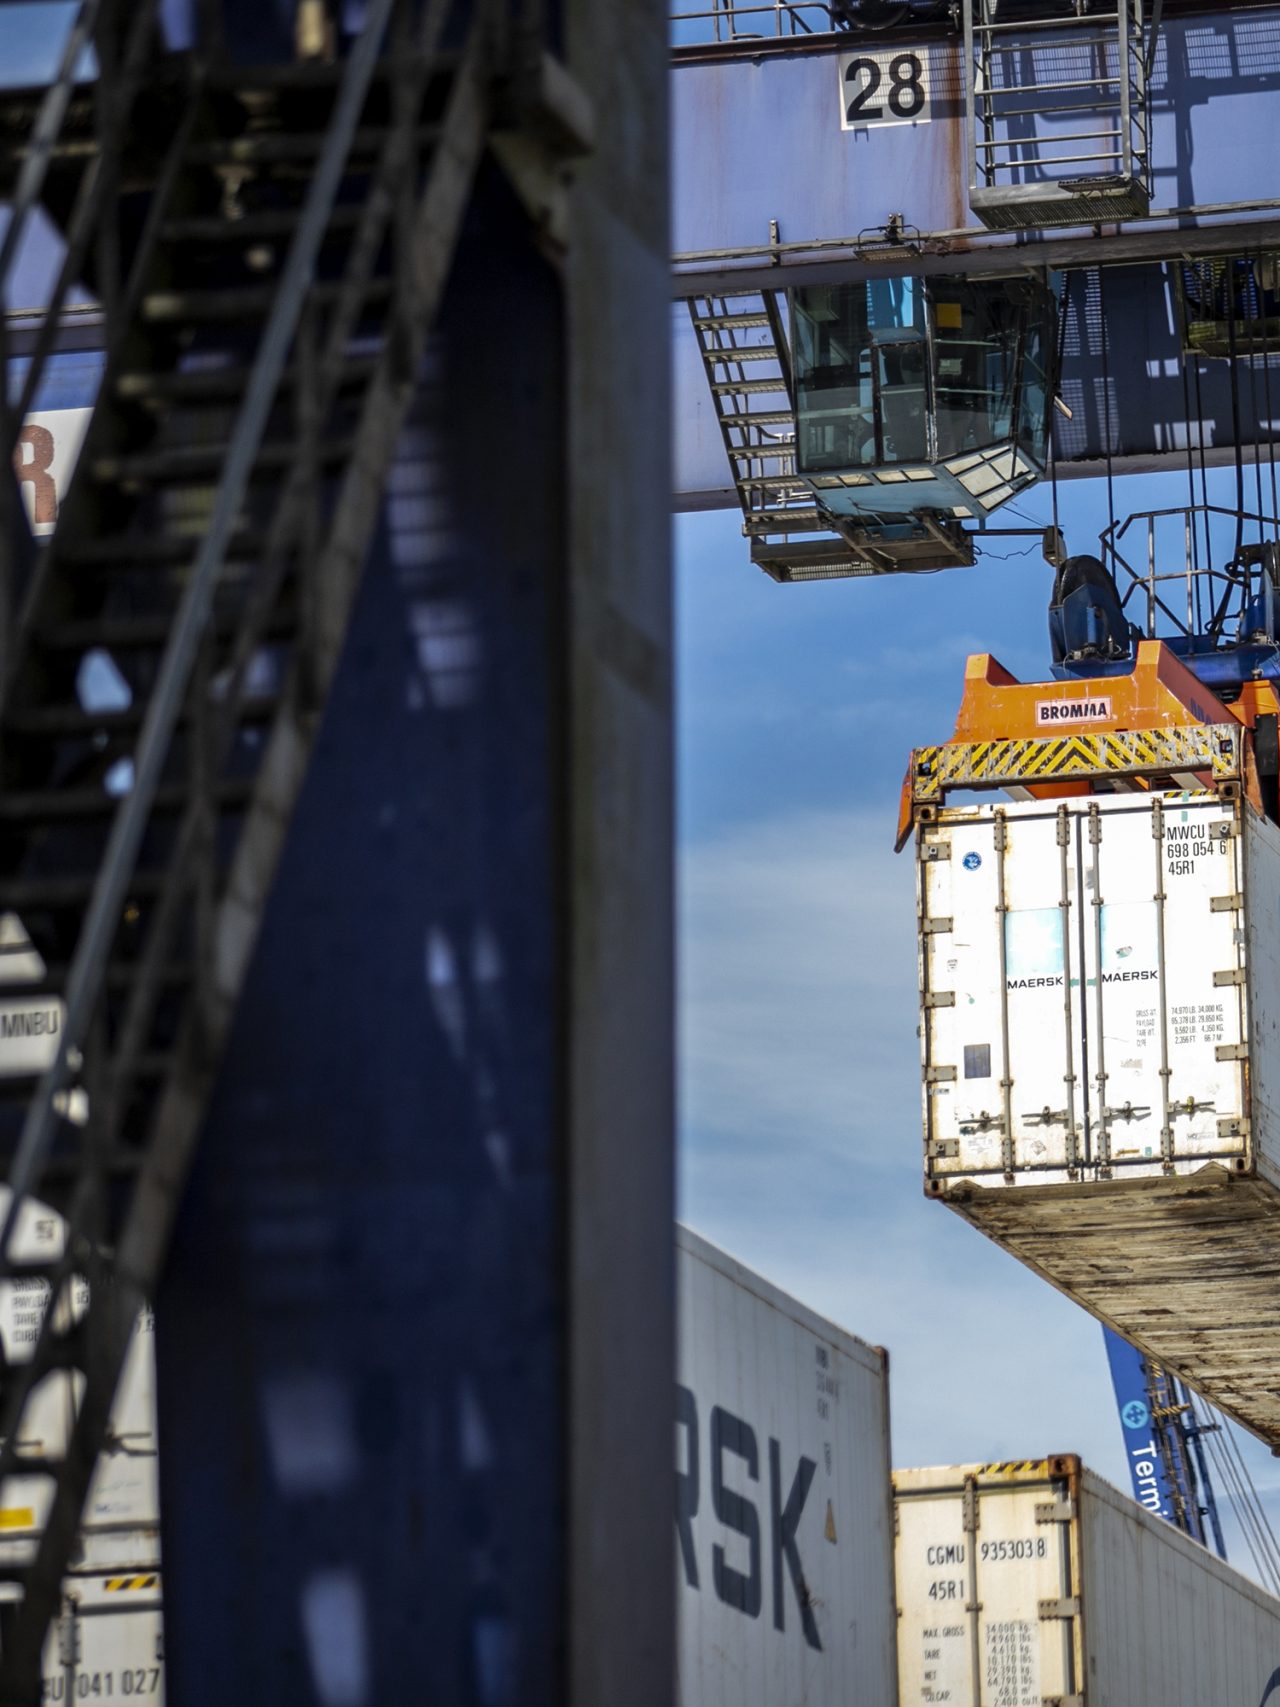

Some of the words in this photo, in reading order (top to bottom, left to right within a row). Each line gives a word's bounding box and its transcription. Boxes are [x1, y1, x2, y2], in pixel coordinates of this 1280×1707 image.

[845, 53, 926, 121] 28
[1040, 702, 1107, 721] BROMMA
[1167, 824, 1205, 841] MWCU
[1167, 843, 1189, 859] 698
[1193, 841, 1214, 857] 054
[1168, 860, 1195, 876] 45R1
[1007, 975, 1064, 990] MAERSK
[1101, 969, 1159, 983] MAERSK
[927, 1545, 965, 1566] CGMU
[928, 1580, 964, 1600] 45R1
[121, 1667, 160, 1697] 027
